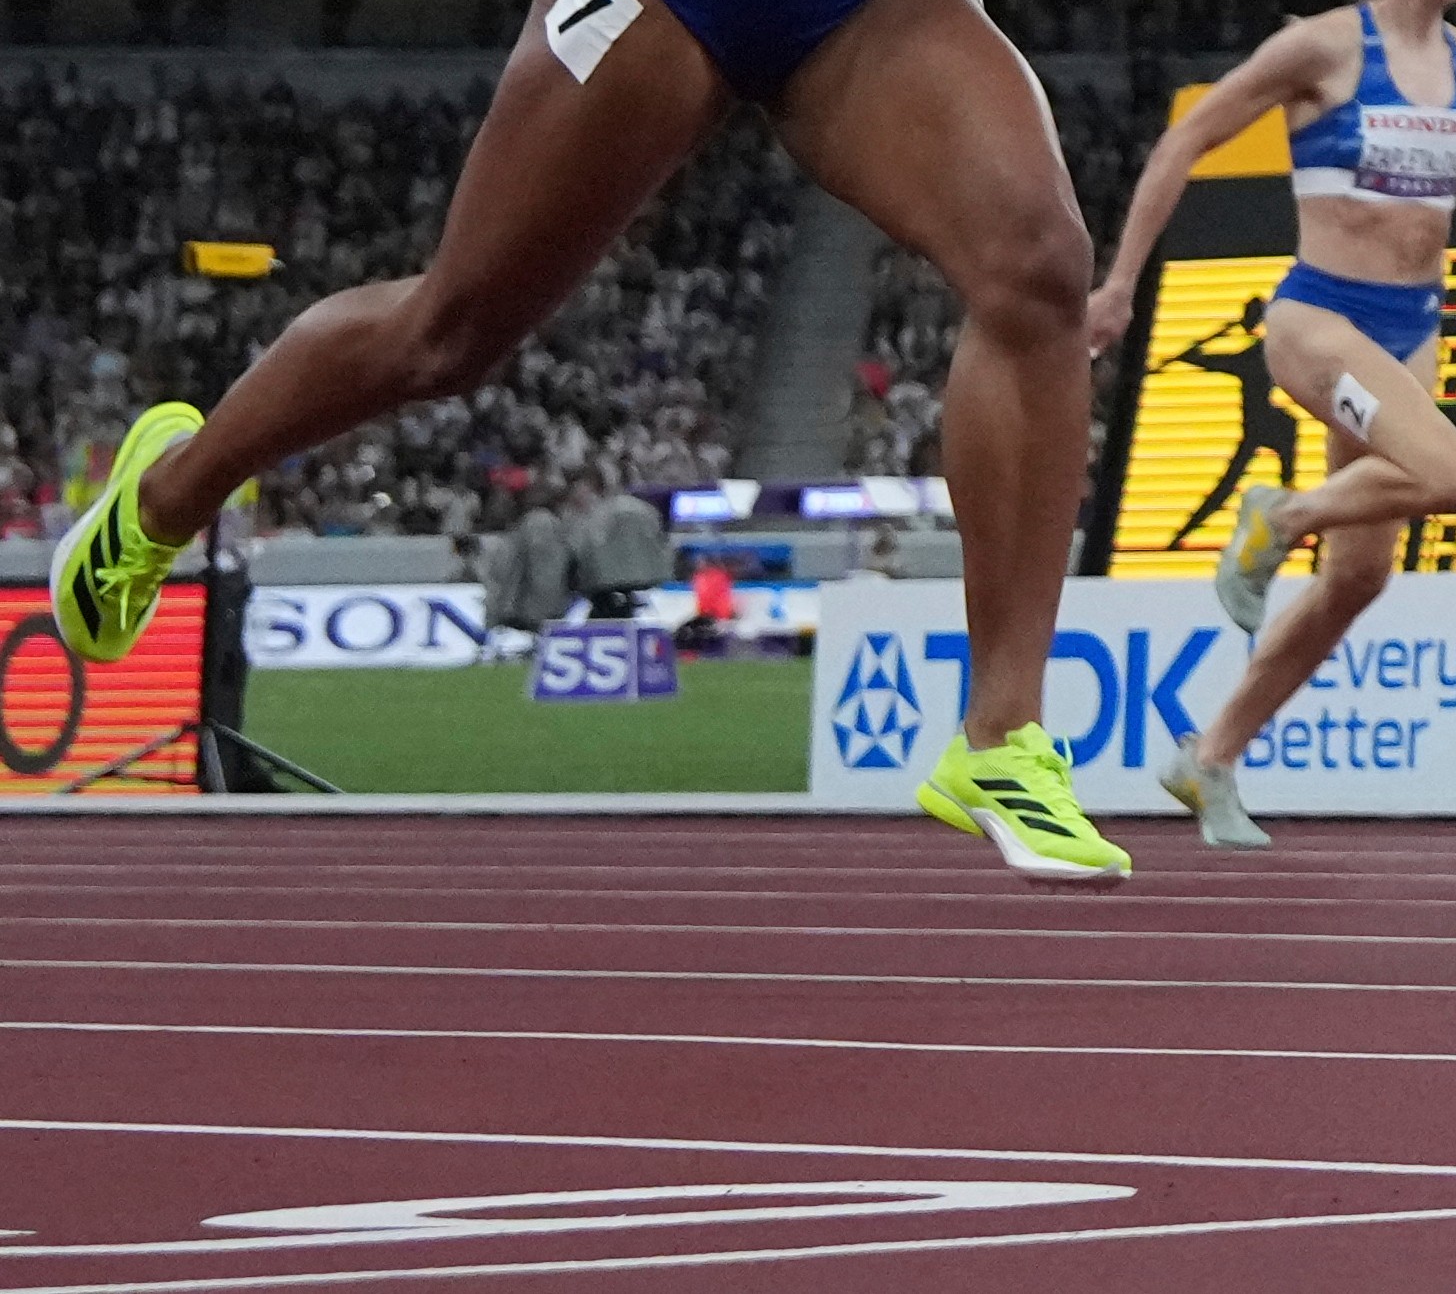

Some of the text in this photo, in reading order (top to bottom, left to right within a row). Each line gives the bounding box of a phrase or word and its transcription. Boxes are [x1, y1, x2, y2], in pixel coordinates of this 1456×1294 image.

[1339, 396, 1366, 426] 2
[253, 593, 491, 655] SON
[541, 634, 631, 693] 55
[924, 627, 1222, 771] TDK
[1242, 707, 1430, 771] Better
